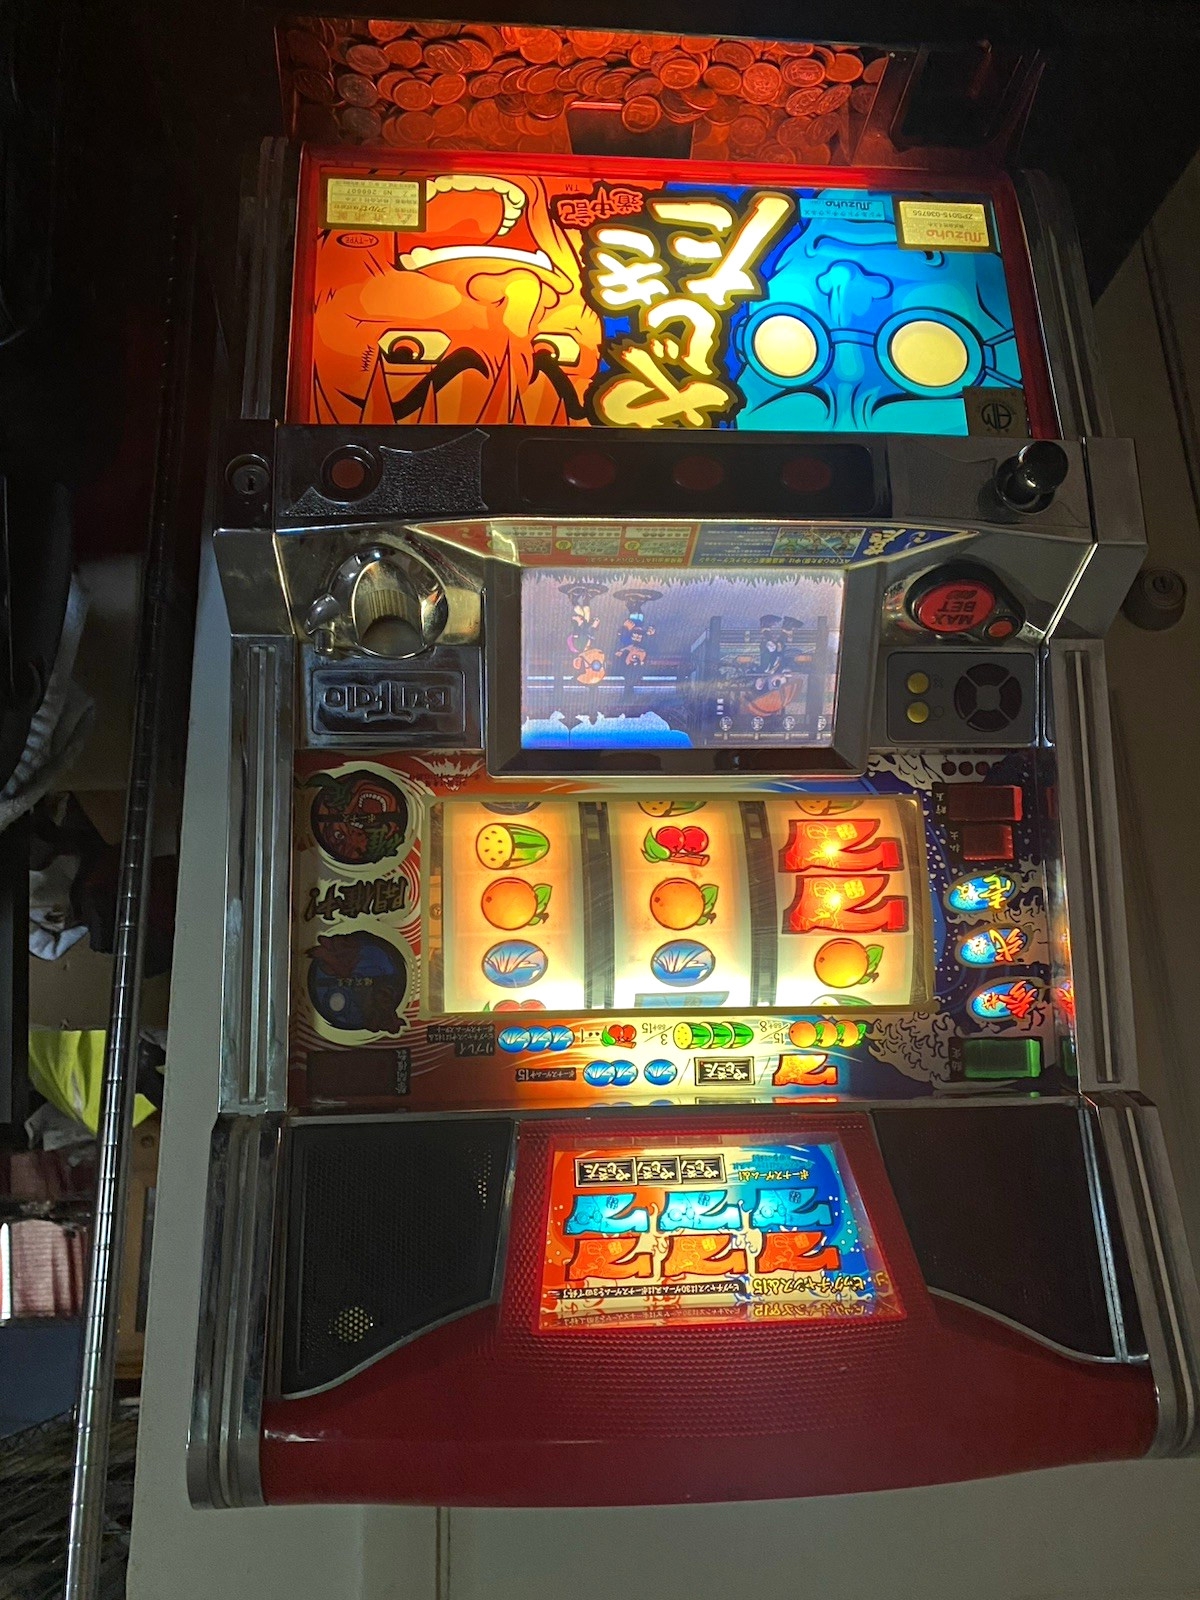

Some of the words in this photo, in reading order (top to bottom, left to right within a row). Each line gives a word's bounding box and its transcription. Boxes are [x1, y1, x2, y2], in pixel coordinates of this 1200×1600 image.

[565, 184, 580, 192] TM
[556, 186, 642, 226] 道中記
[824, 200, 873, 212] Mizuho
[344, 236, 375, 247] A-TYPE
[937, 601, 977, 613] BET
[932, 614, 974, 626] MAX
[342, 814, 376, 825] ボーナス
[303, 877, 408, 921] 開催中!
[459, 1042, 494, 1055] リプレイ
[701, 1062, 749, 1081] やじきた
[582, 1162, 631, 1181] やじきた
